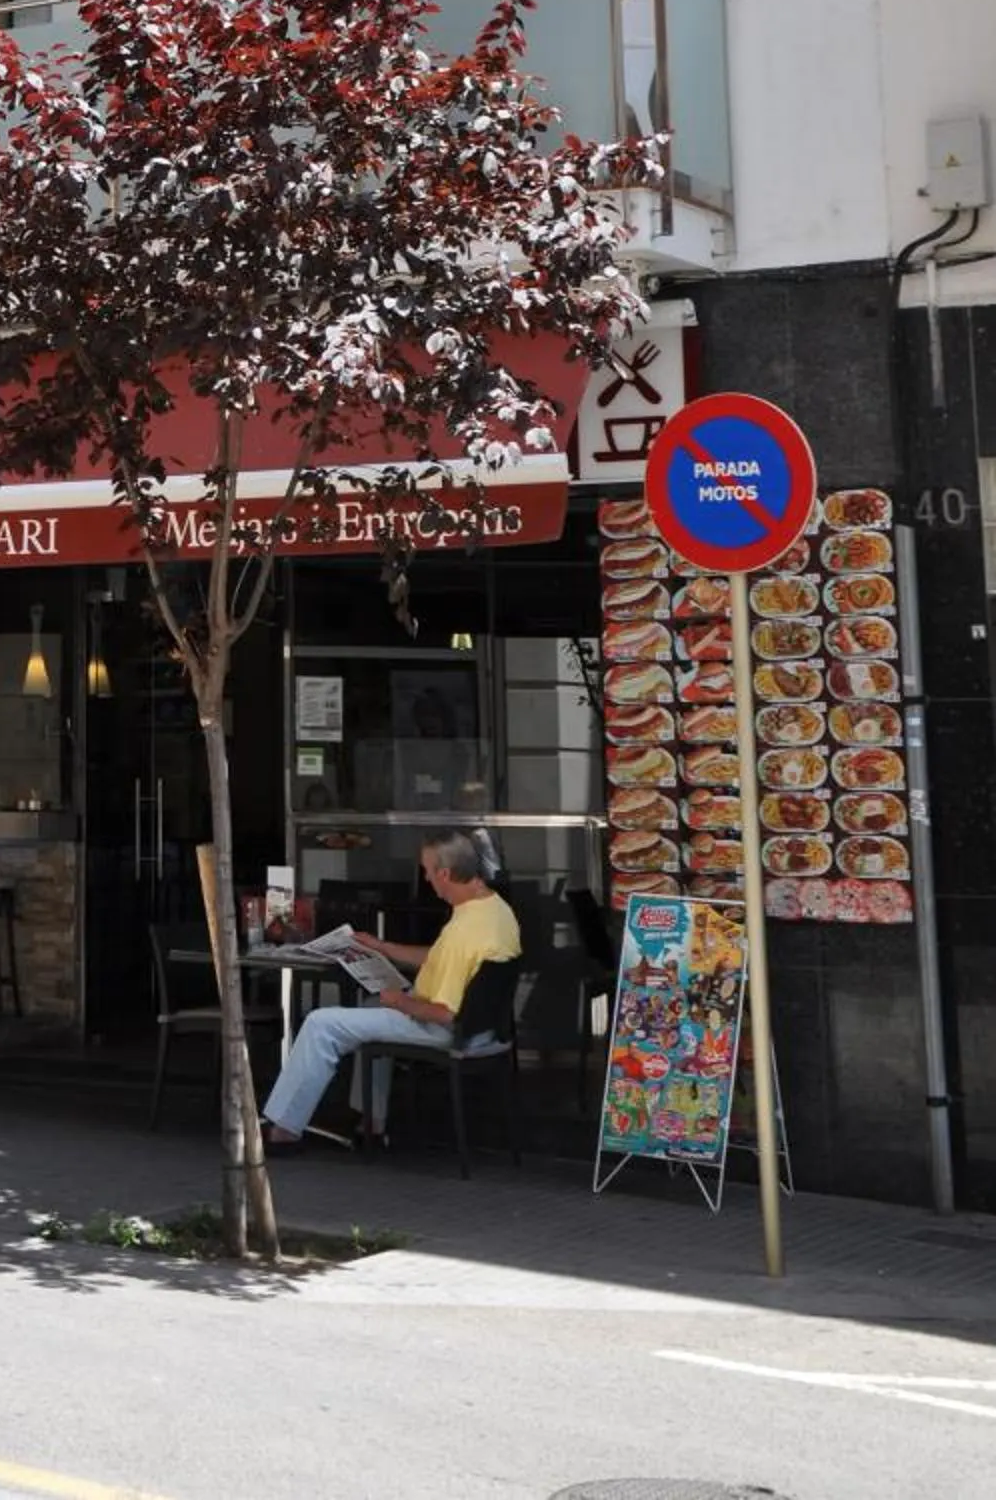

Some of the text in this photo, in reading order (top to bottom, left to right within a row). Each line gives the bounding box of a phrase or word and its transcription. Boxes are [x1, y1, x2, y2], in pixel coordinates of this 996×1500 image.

[693, 460, 762, 479] PARADA
[699, 485, 759, 503] MOTOS
[915, 487, 966, 526] 40
